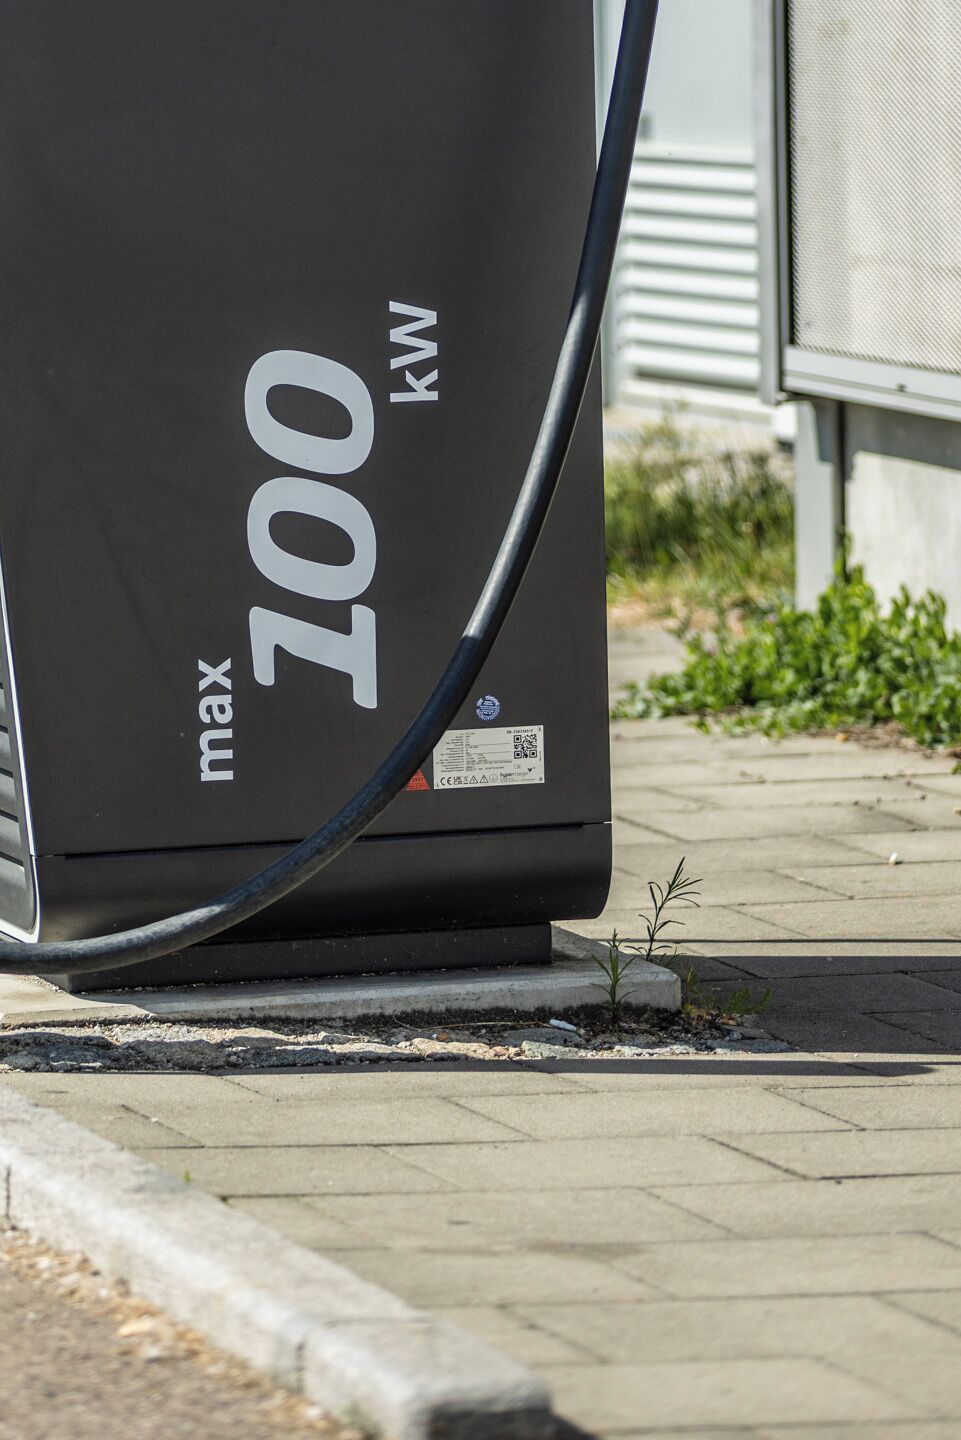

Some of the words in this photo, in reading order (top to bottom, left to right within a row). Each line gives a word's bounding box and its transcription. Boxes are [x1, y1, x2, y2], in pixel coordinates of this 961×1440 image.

[389, 300, 439, 403] kW
[244, 349, 378, 710] 100
[198, 658, 234, 782] max
